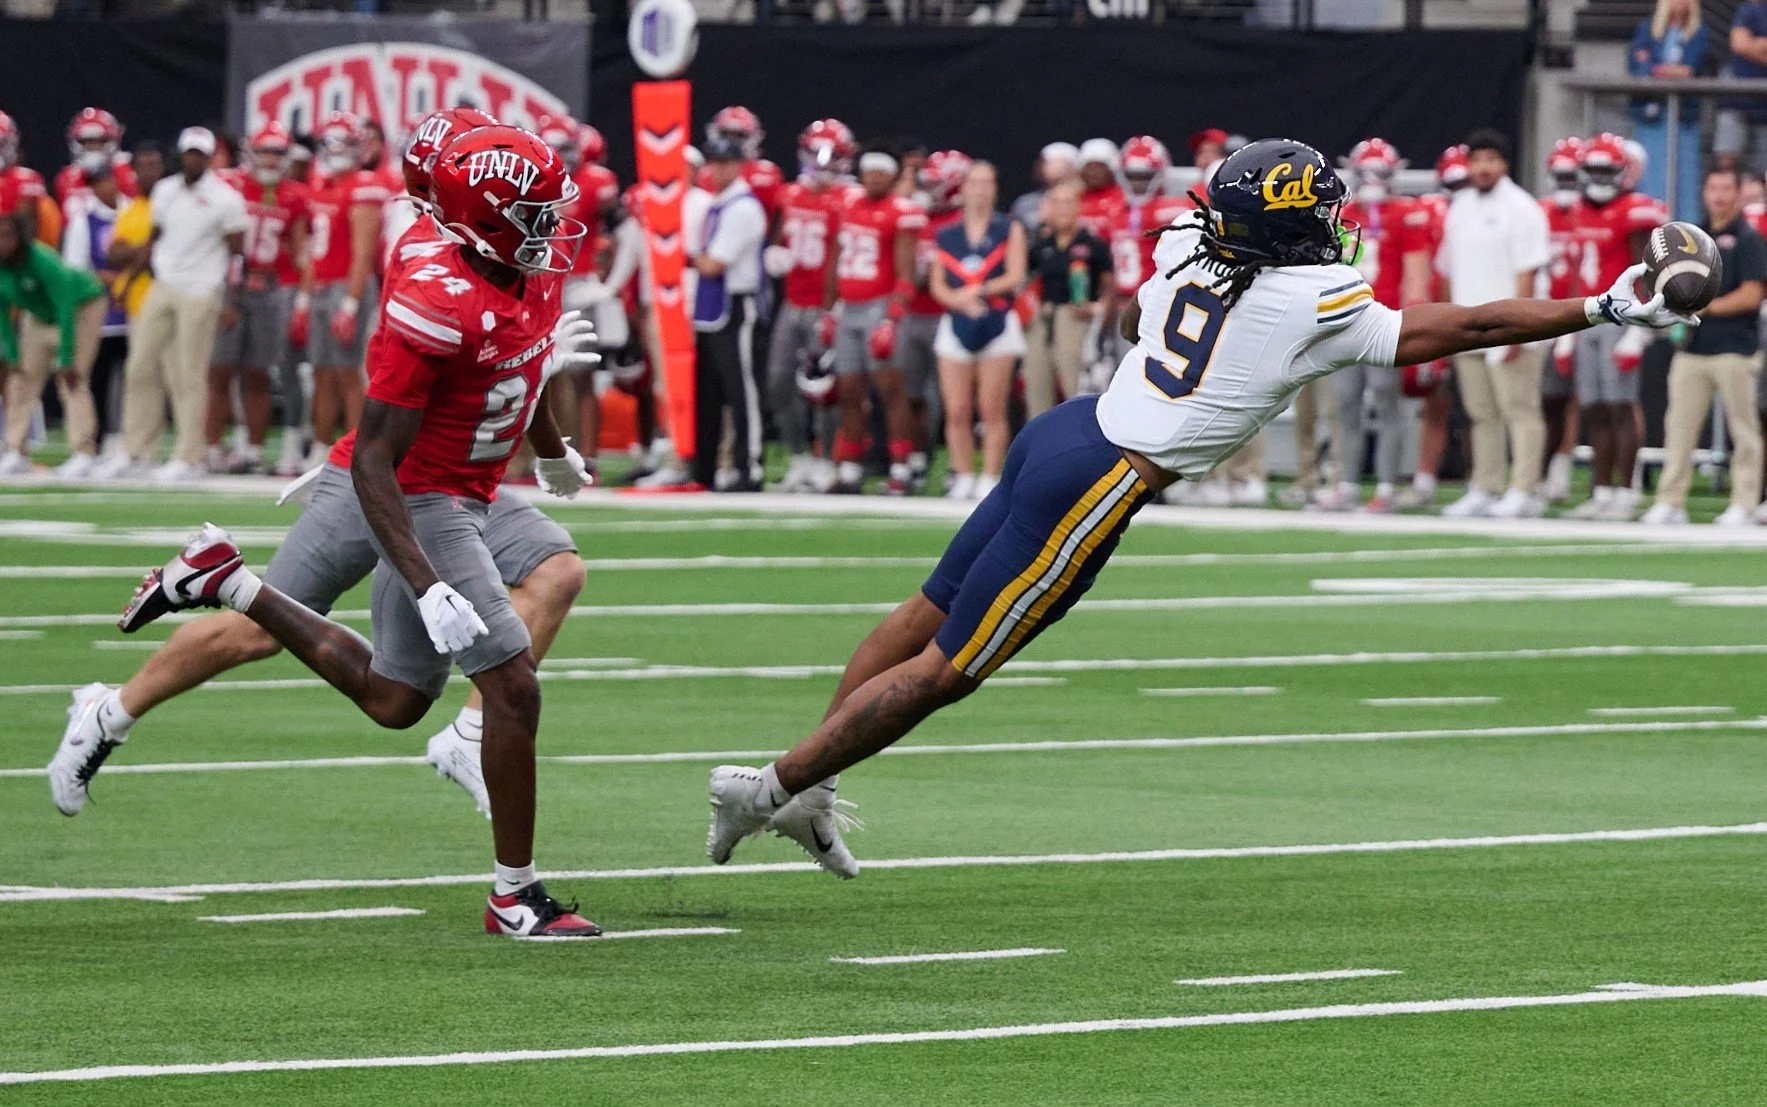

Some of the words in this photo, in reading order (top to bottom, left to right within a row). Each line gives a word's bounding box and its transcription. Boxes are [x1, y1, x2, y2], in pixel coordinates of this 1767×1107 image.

[468, 150, 540, 196] UNLV
[1262, 163, 1319, 211] Cal
[409, 263, 473, 297] 24
[1145, 280, 1228, 400] 9
